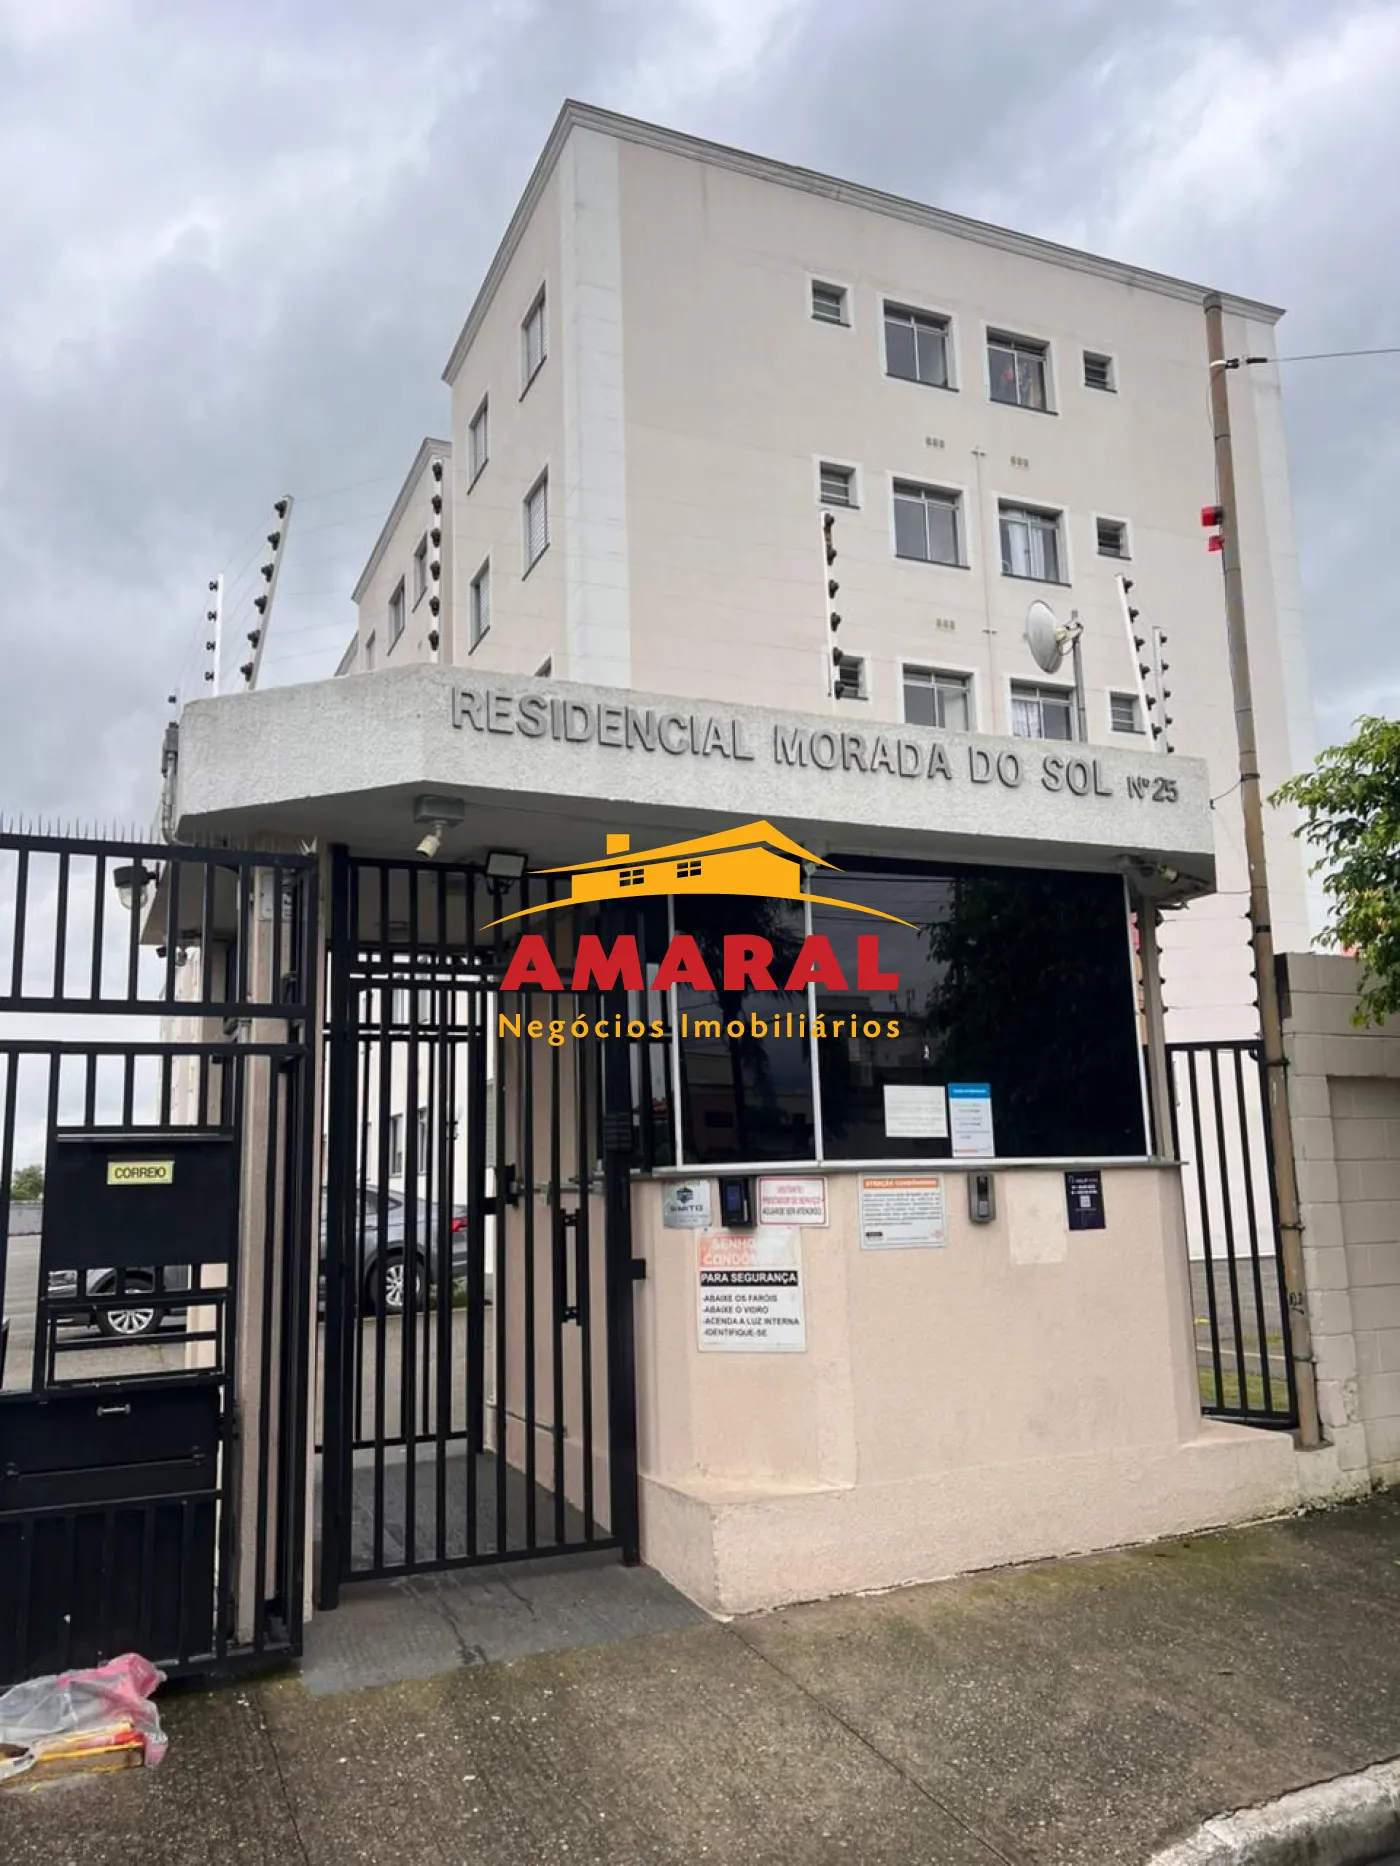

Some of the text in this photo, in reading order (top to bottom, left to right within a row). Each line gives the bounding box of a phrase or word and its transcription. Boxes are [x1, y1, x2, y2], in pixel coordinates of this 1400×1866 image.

[452, 687, 755, 761] RESIDENCIAL
[773, 724, 952, 781] MORADA
[969, 745, 1024, 788] DO
[1041, 755, 1113, 797] SOL
[1152, 776, 1179, 803] 25
[114, 1165, 168, 1179] CORREIO
[702, 1272, 797, 1285] PARA SEGURANÇA
[734, 1294, 748, 1303] OS
[748, 1293, 778, 1303] FARÓIS
[734, 1305, 743, 1314] O
[743, 1305, 769, 1314] VIDRO
[739, 1317, 746, 1326] A
[746, 1317, 763, 1326] LUZ
[763, 1317, 800, 1326] INTERNA
